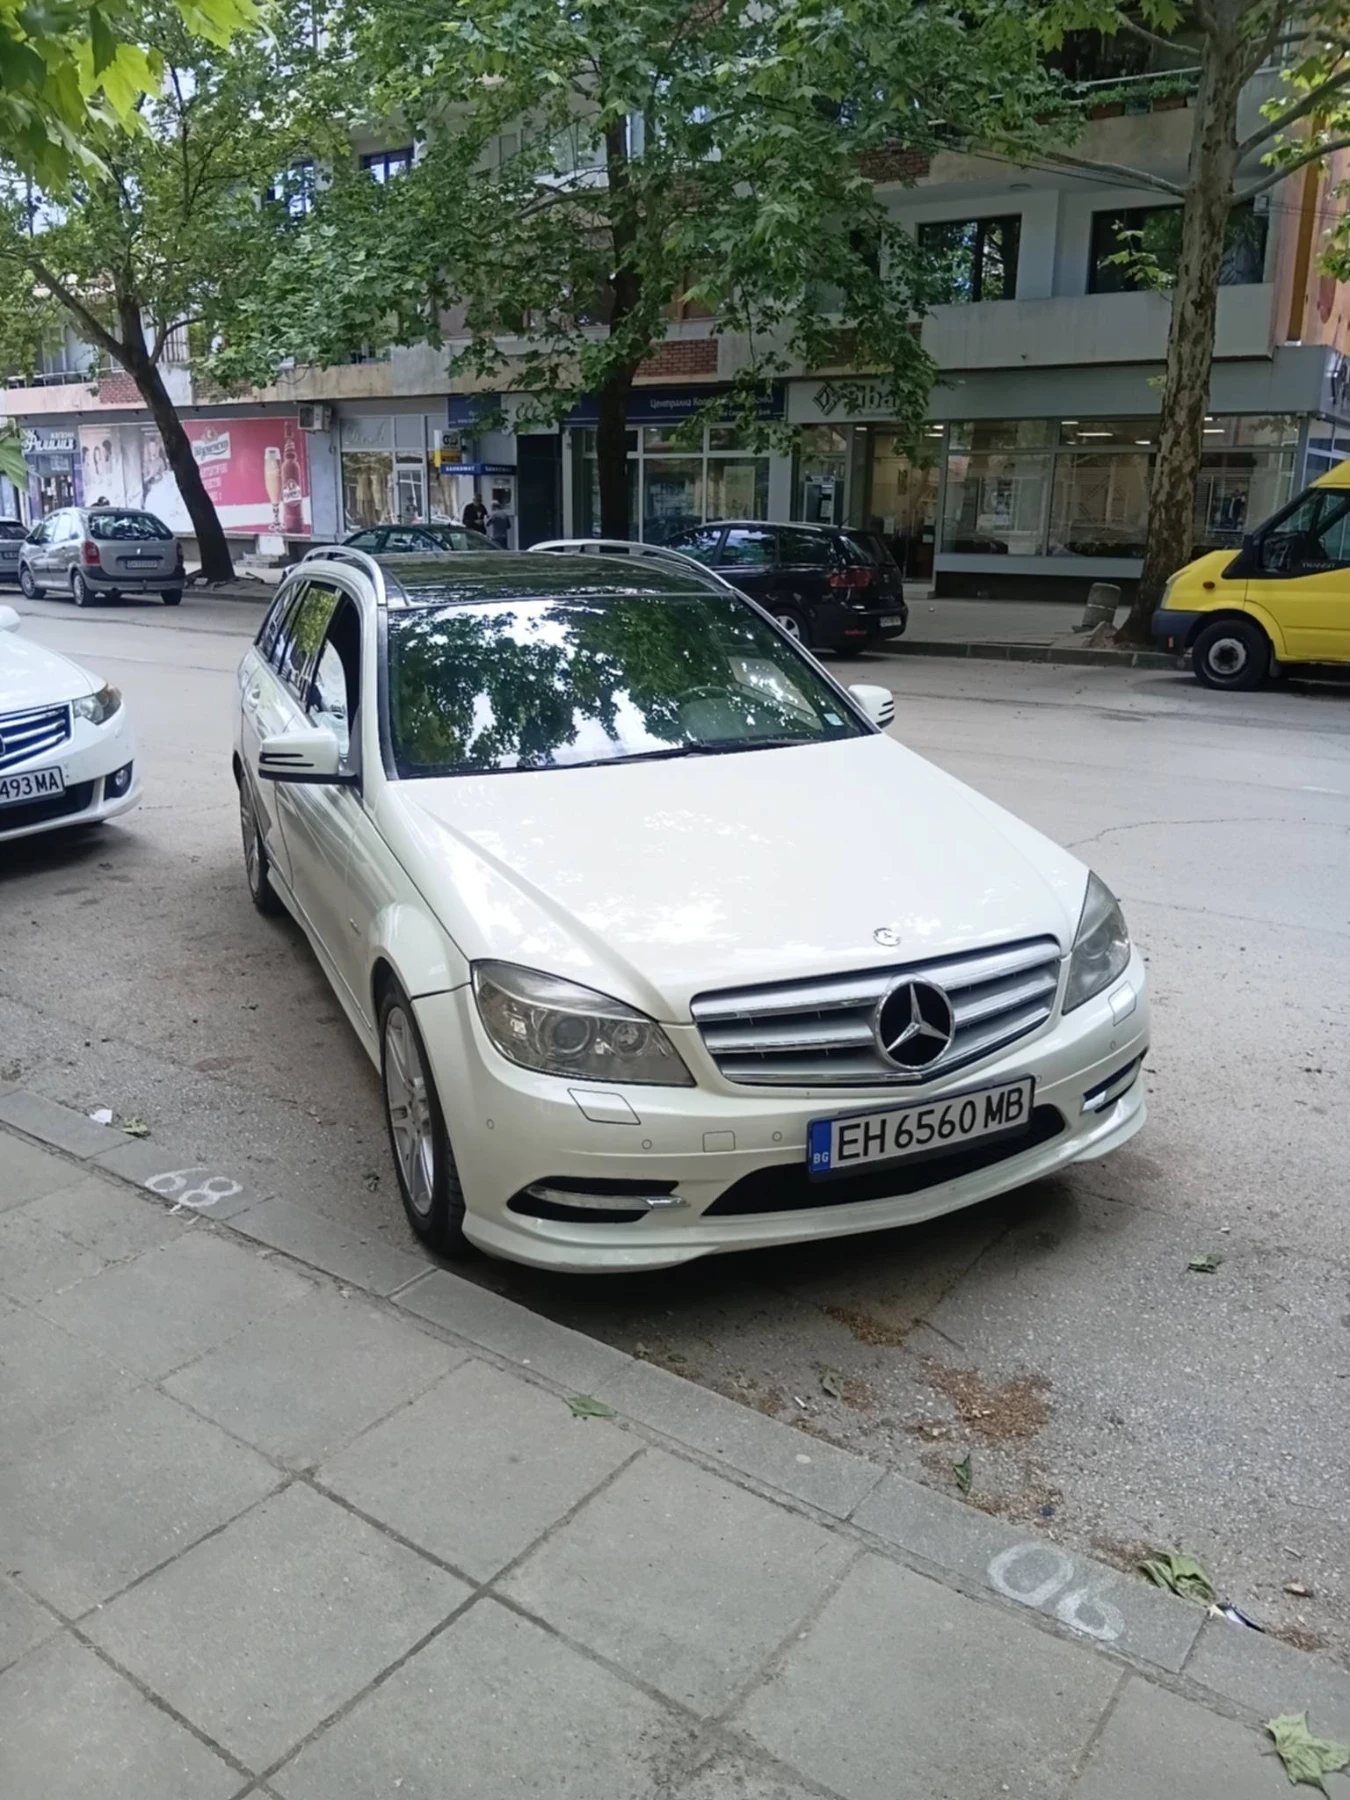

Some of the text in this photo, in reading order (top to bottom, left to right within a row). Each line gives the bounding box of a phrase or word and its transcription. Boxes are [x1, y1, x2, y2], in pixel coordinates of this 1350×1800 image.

[34, 772, 60, 793] MA
[838, 1086, 1024, 1161] EH 6560 MB
[813, 1151, 829, 1165] BG
